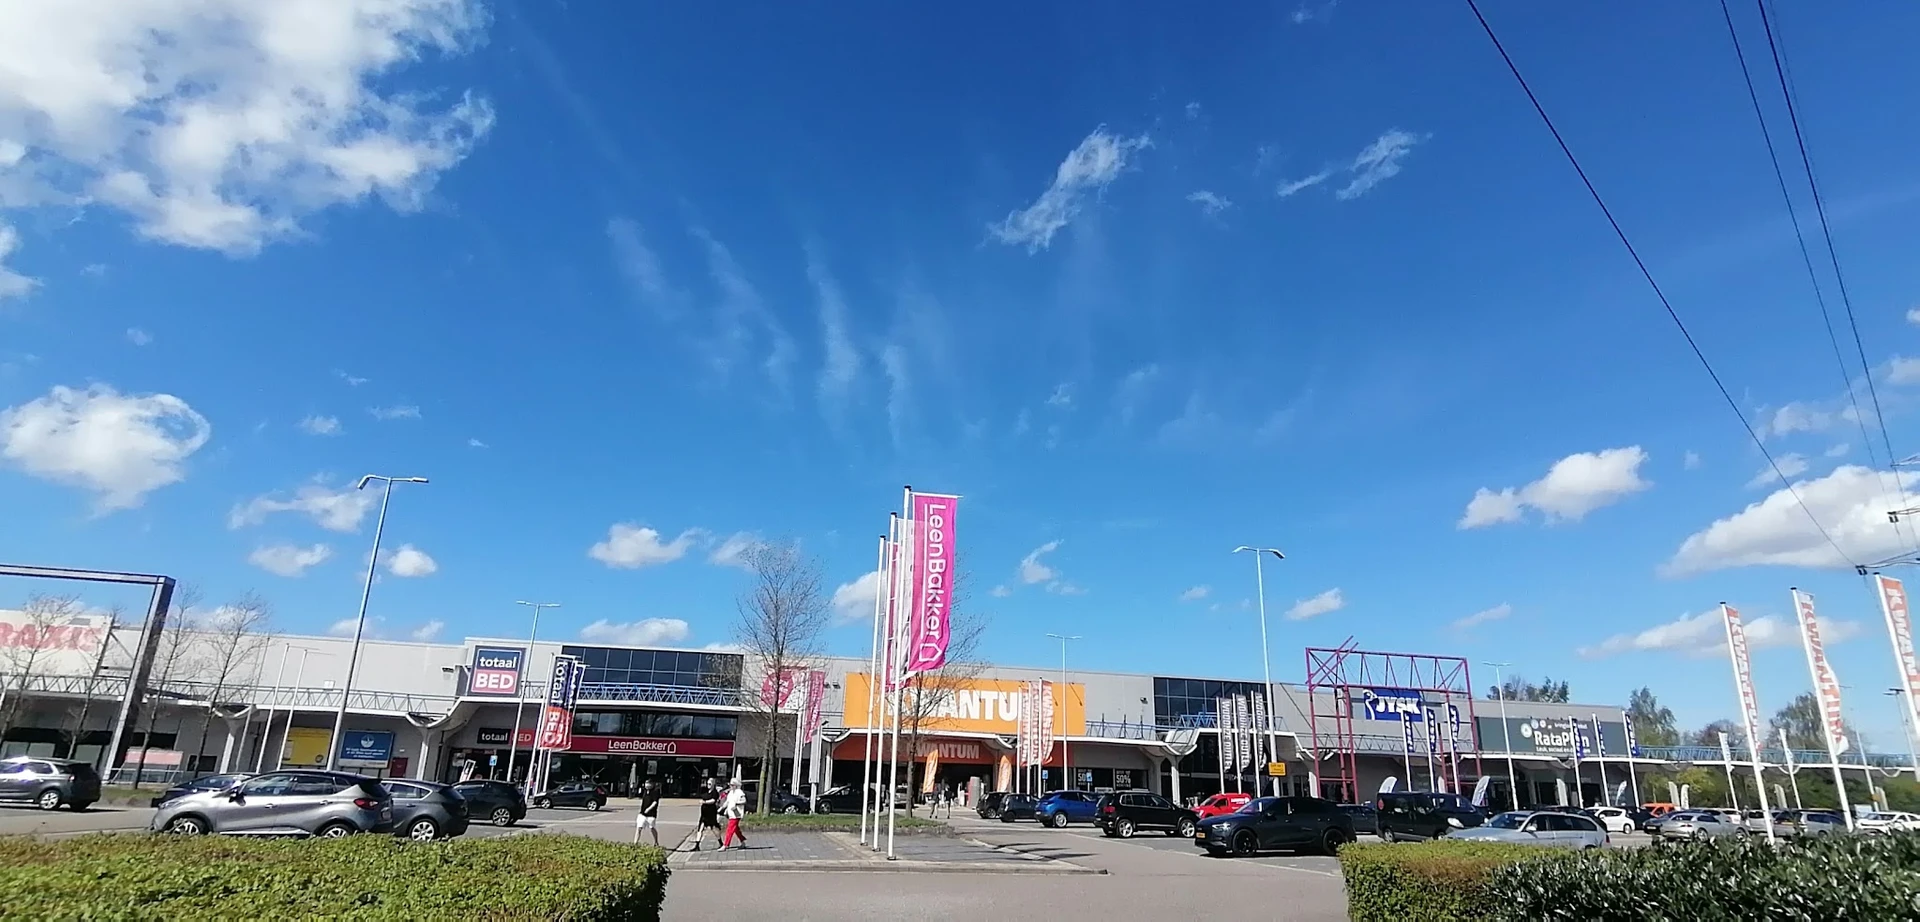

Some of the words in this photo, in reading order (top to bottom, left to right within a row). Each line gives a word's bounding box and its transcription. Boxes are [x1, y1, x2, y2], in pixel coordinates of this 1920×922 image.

[926, 504, 946, 640] LeenBakker
[480, 656, 517, 668] totaal
[475, 673, 514, 689] BED
[551, 661, 568, 704] totaal
[1376, 696, 1420, 715] JYSK
[545, 712, 560, 743] BED
[481, 733, 508, 741] totaal
[512, 734, 531, 742] ED
[608, 740, 667, 751] LeenBakker
[1534, 731, 1590, 747] RataPln
